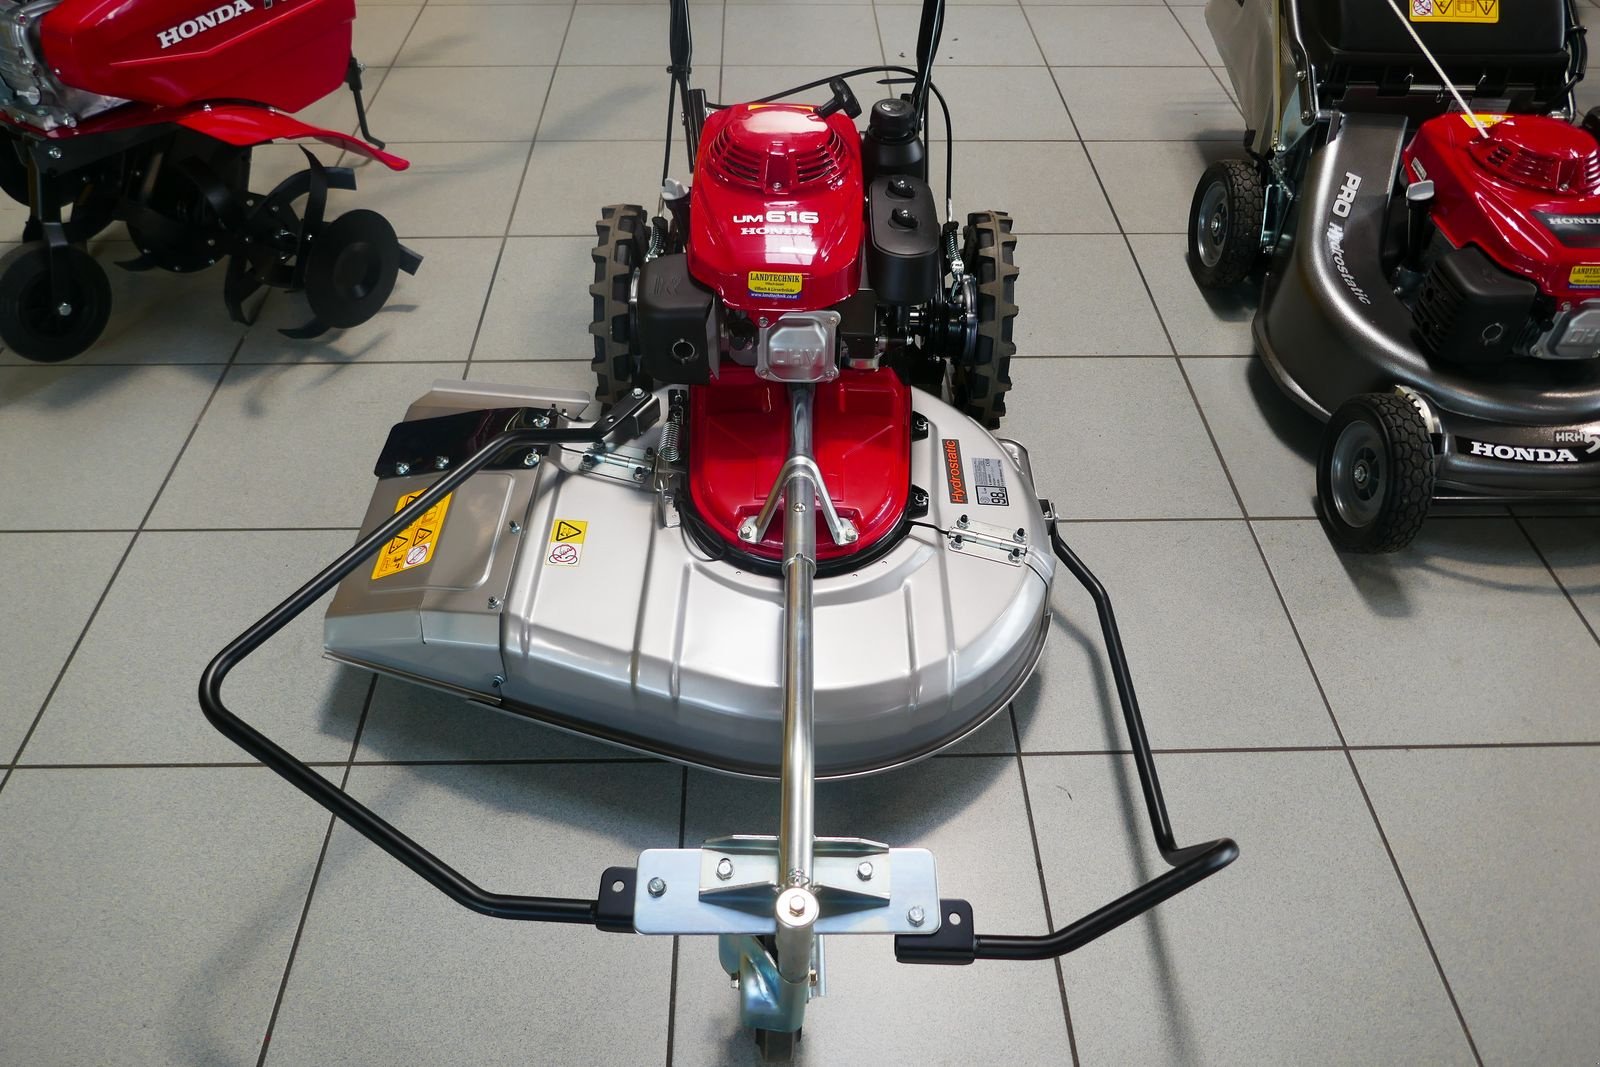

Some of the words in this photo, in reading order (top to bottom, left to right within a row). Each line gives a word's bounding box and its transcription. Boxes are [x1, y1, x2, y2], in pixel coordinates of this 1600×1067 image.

[156, 0, 255, 49] HONDA
[1332, 171, 1362, 218] PRO
[732, 214, 764, 224] UM
[765, 209, 820, 224] 616
[1547, 217, 1600, 225] HOND
[740, 227, 812, 236] HONDA
[1326, 221, 1371, 305] Hydrostatic
[750, 273, 801, 283] LANDTECHNIK
[1470, 441, 1578, 462] HONDA
[945, 440, 966, 503] Hydrostatic
[990, 492, 1006, 504] 98
